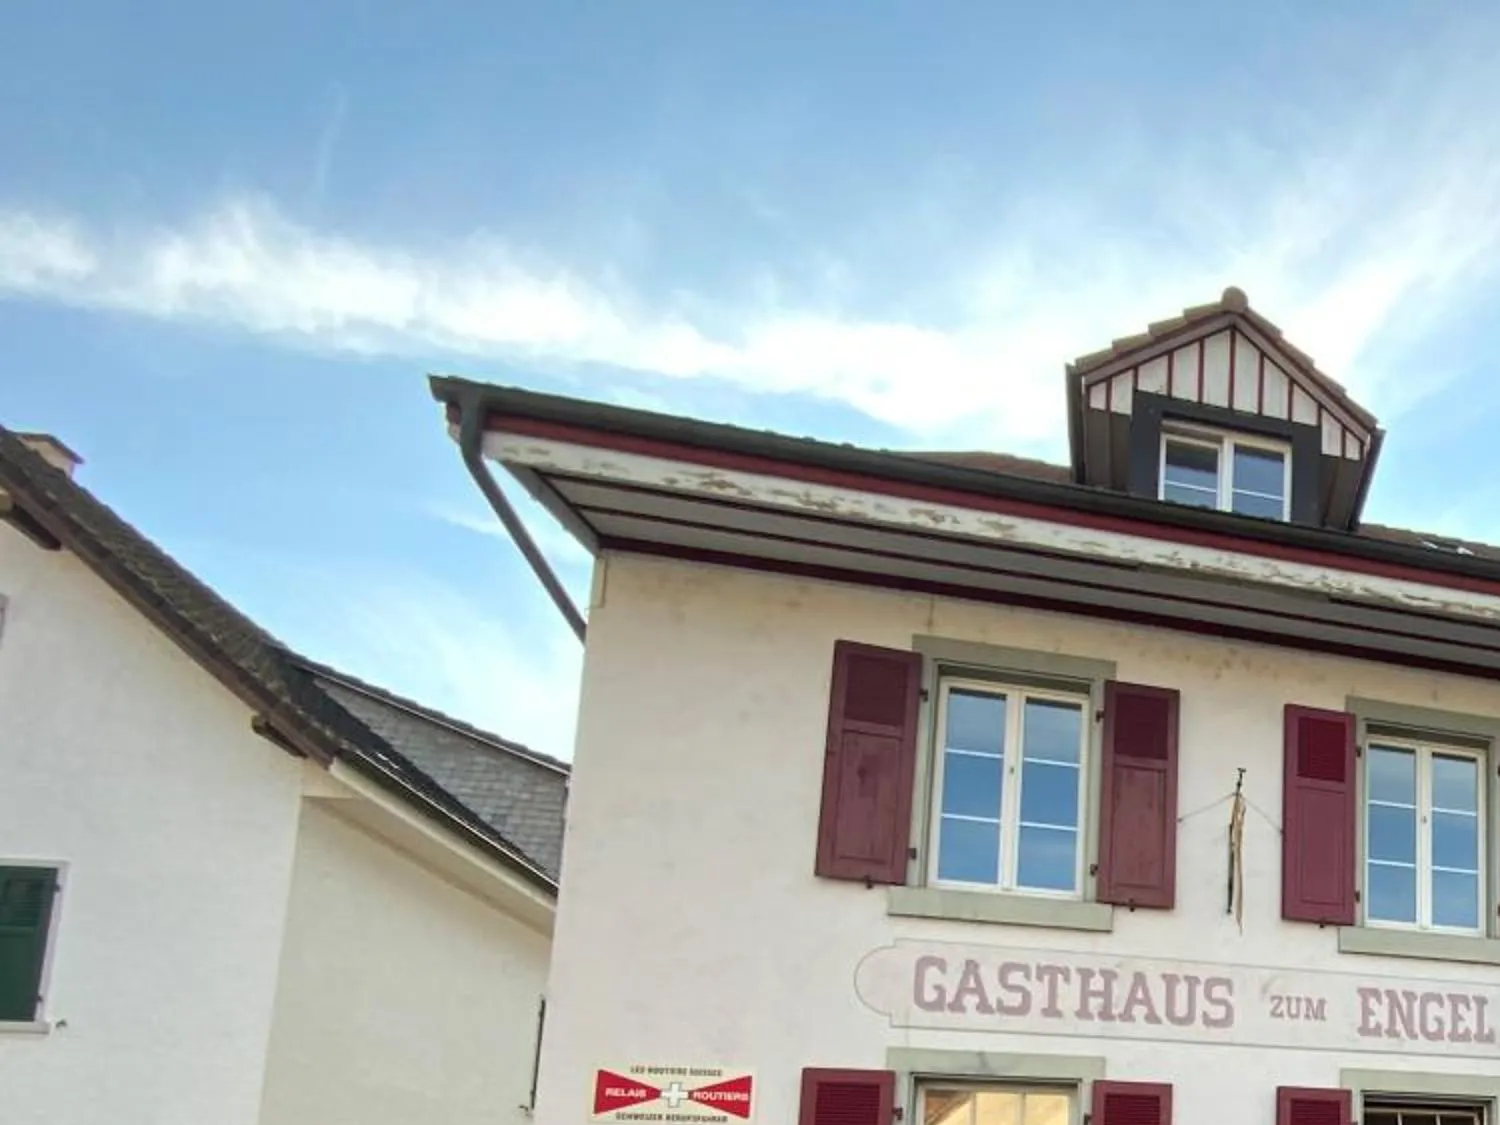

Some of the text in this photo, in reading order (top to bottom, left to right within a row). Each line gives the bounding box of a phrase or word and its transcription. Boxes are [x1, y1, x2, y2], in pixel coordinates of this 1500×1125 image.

[912, 954, 1497, 1044] GASTHAUS ZUM ENGEL
[604, 1087, 750, 1102] RELAIS ROUTIERS
